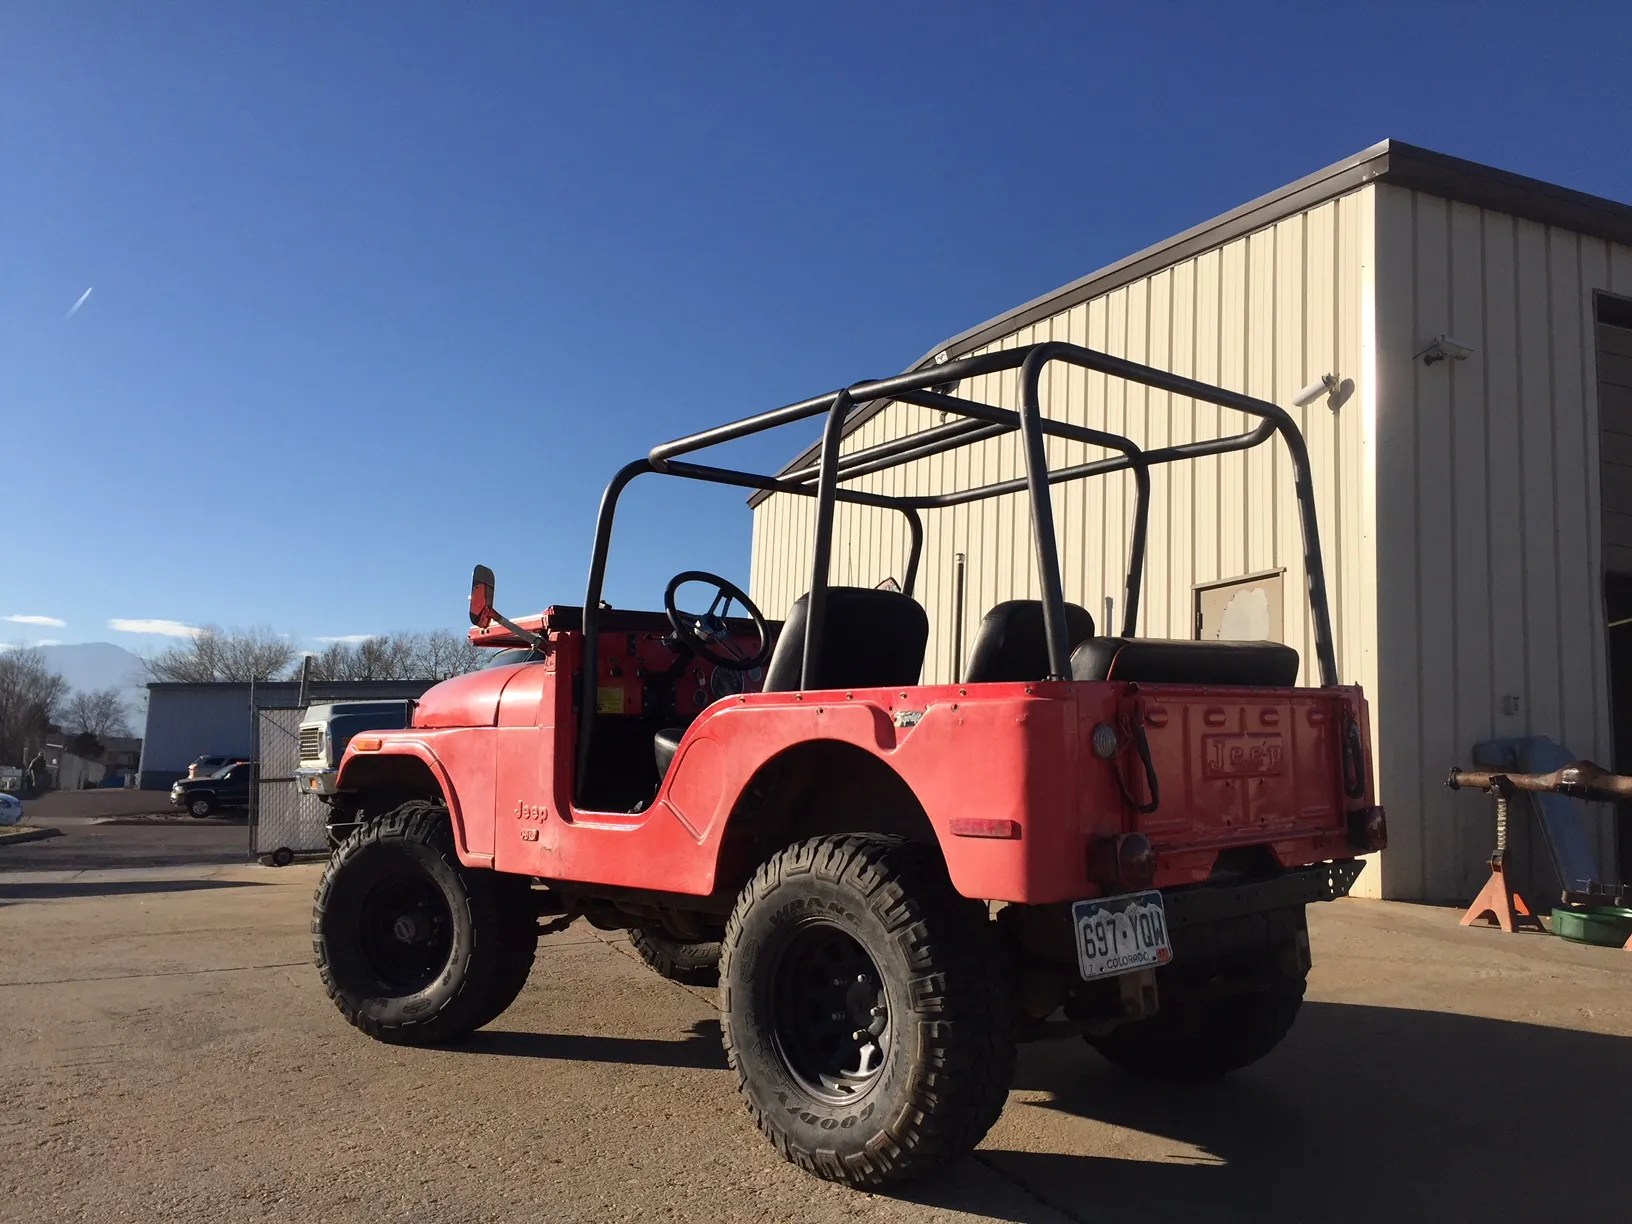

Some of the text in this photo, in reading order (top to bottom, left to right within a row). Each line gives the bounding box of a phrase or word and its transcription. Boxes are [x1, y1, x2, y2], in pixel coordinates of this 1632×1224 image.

[1208, 741, 1281, 769] Jeep
[514, 799, 548, 824] Jeep
[1107, 952, 1149, 968] COLORADO
